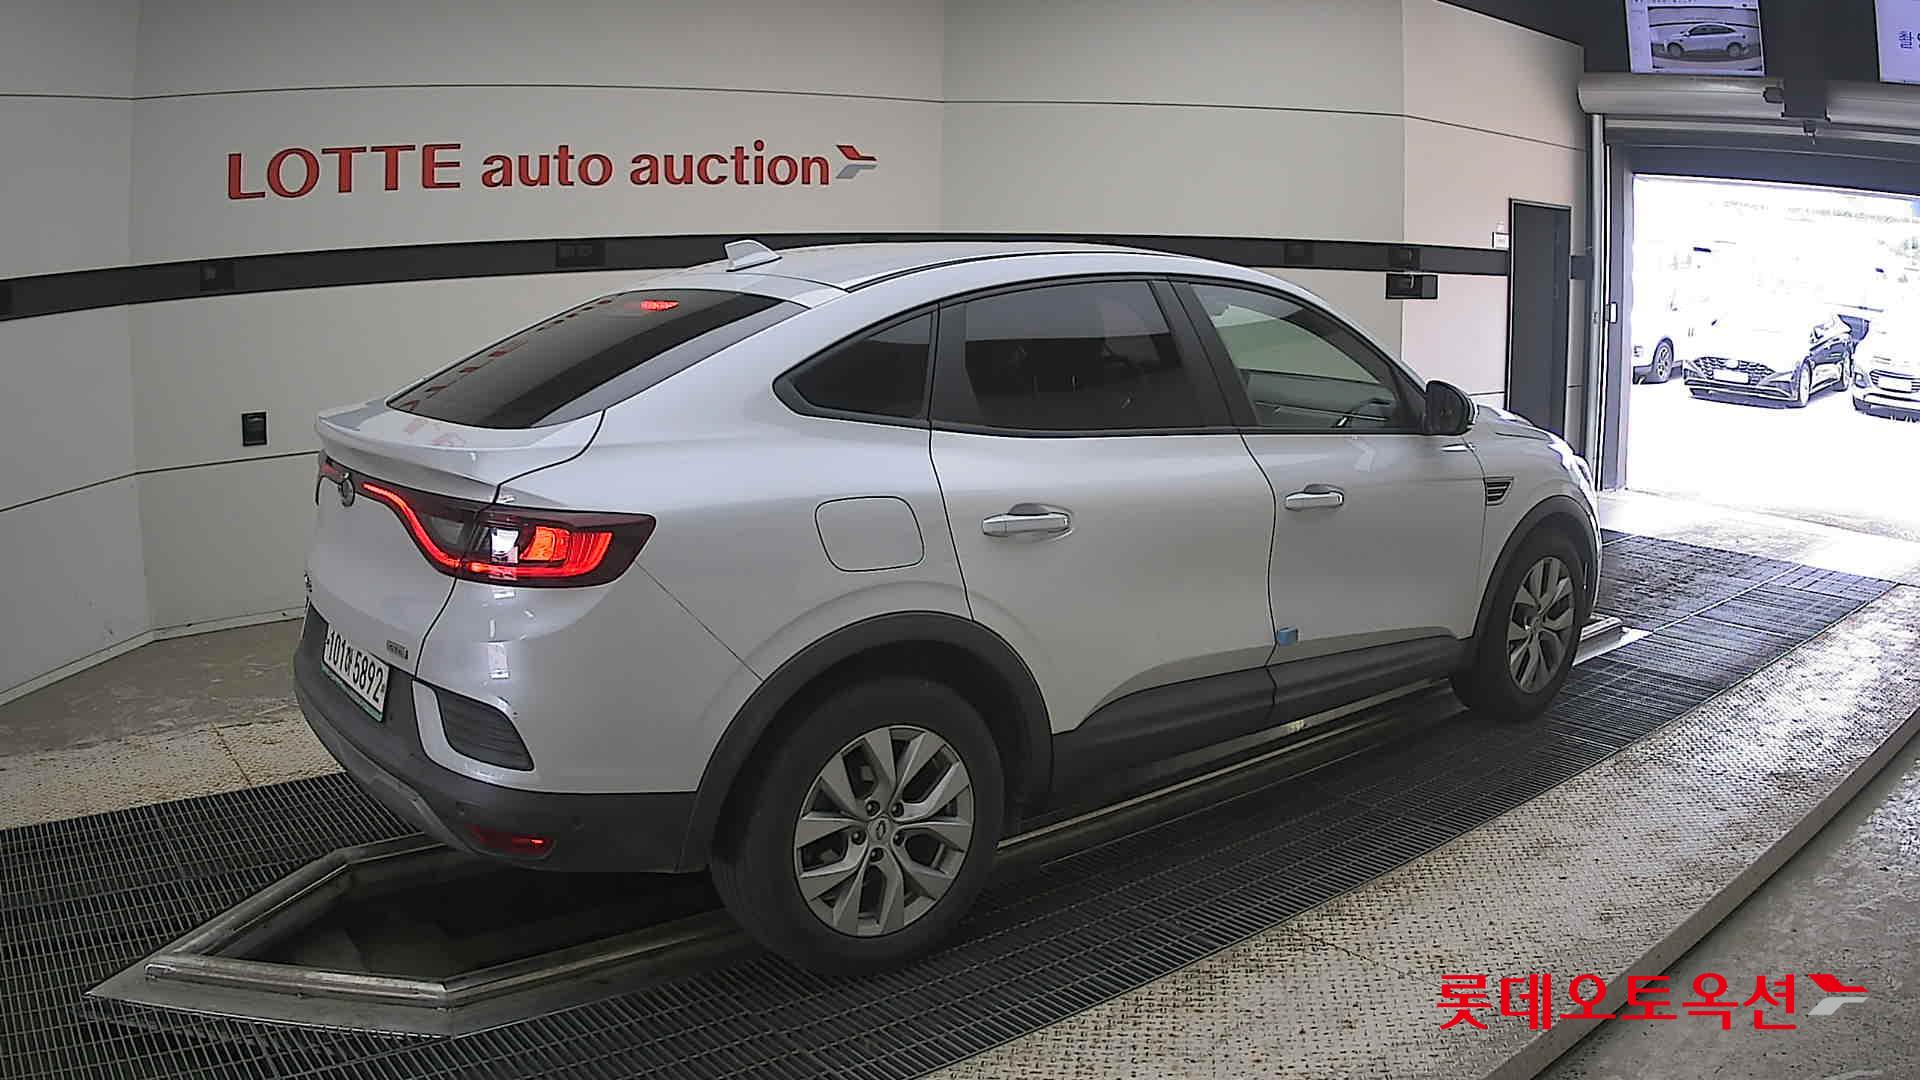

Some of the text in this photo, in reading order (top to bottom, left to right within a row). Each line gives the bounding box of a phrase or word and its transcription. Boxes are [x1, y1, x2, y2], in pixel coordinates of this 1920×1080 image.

[227, 140, 831, 200] LOTTE auto auction
